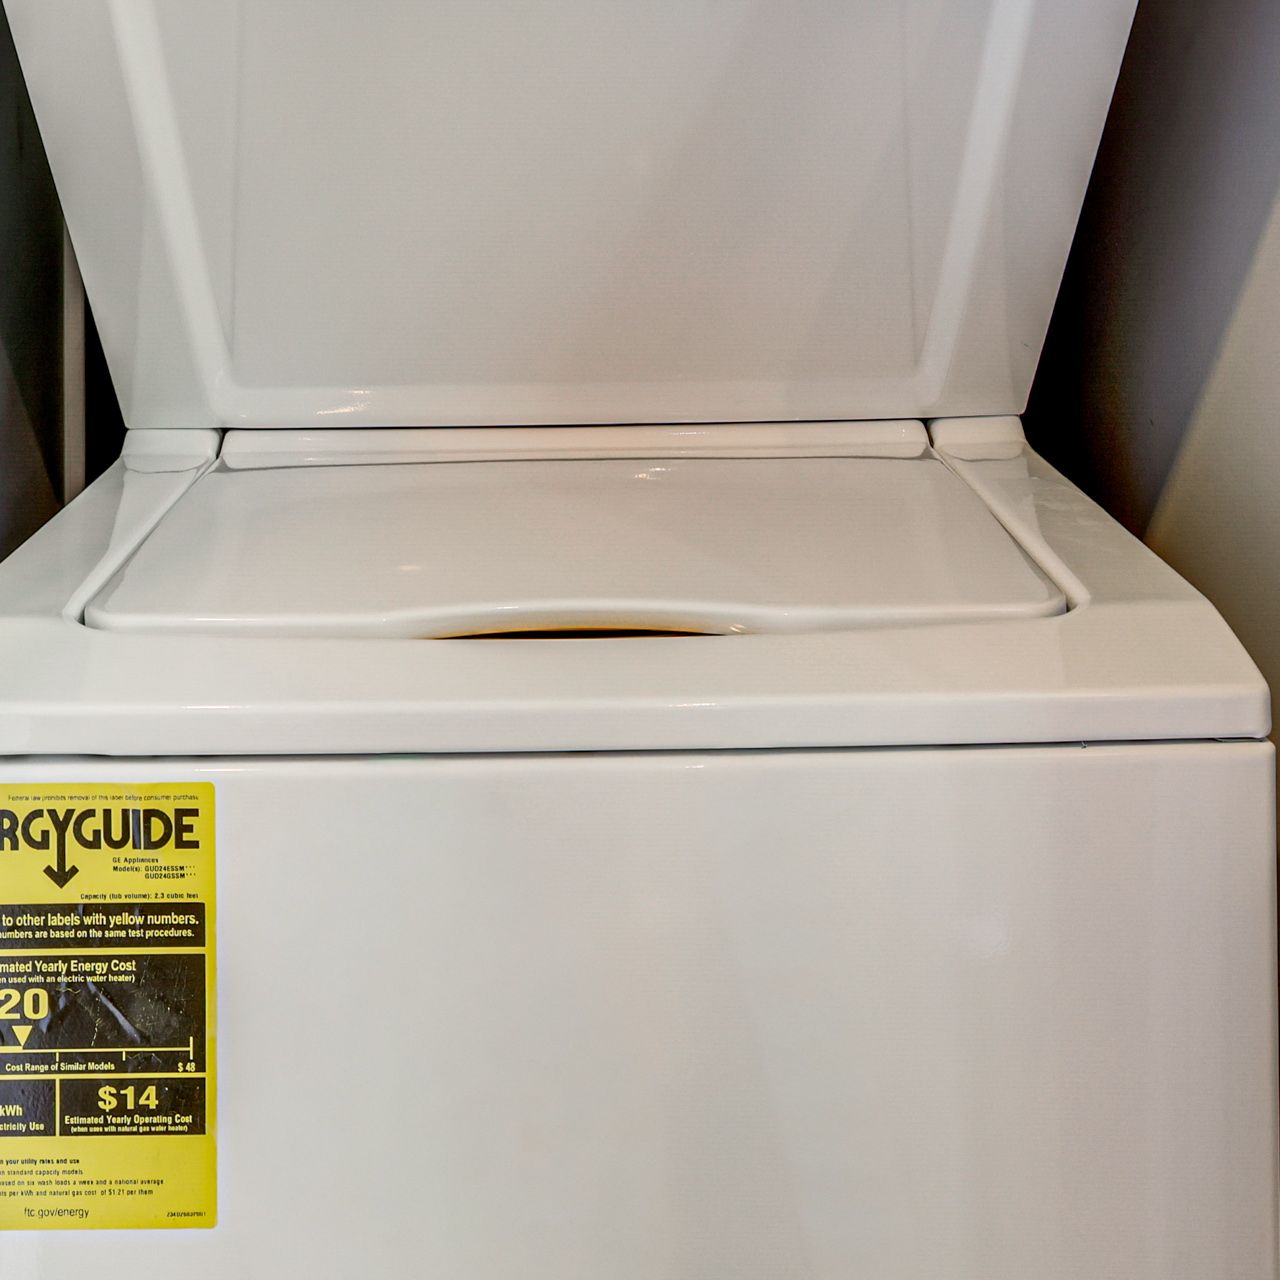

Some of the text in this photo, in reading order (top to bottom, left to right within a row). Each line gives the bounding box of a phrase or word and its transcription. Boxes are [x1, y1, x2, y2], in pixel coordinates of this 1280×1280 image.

[2, 914, 13, 926] to
[16, 913, 45, 926] other
[48, 913, 80, 926] labels
[83, 912, 106, 925] with
[109, 912, 144, 928] yellow
[147, 912, 199, 924] numbers.
[35, 930, 48, 938] are
[50, 929, 75, 938] based
[77, 930, 87, 938] on
[89, 928, 102, 937] the
[128, 928, 144, 937] test
[146, 927, 195, 939] procedures.
[35, 960, 68, 974] Yearly
[70, 960, 108, 974] Energy
[111, 959, 136, 971] Cost
[5, 1062, 115, 1072] Cost Range of Similar Models
[97, 1085, 159, 1112] $14
[0, 1105, 23, 1117] kWh
[65, 1113, 193, 1126] Estimated Yearly Operating Cost
[29, 1121, 45, 1131] Use
